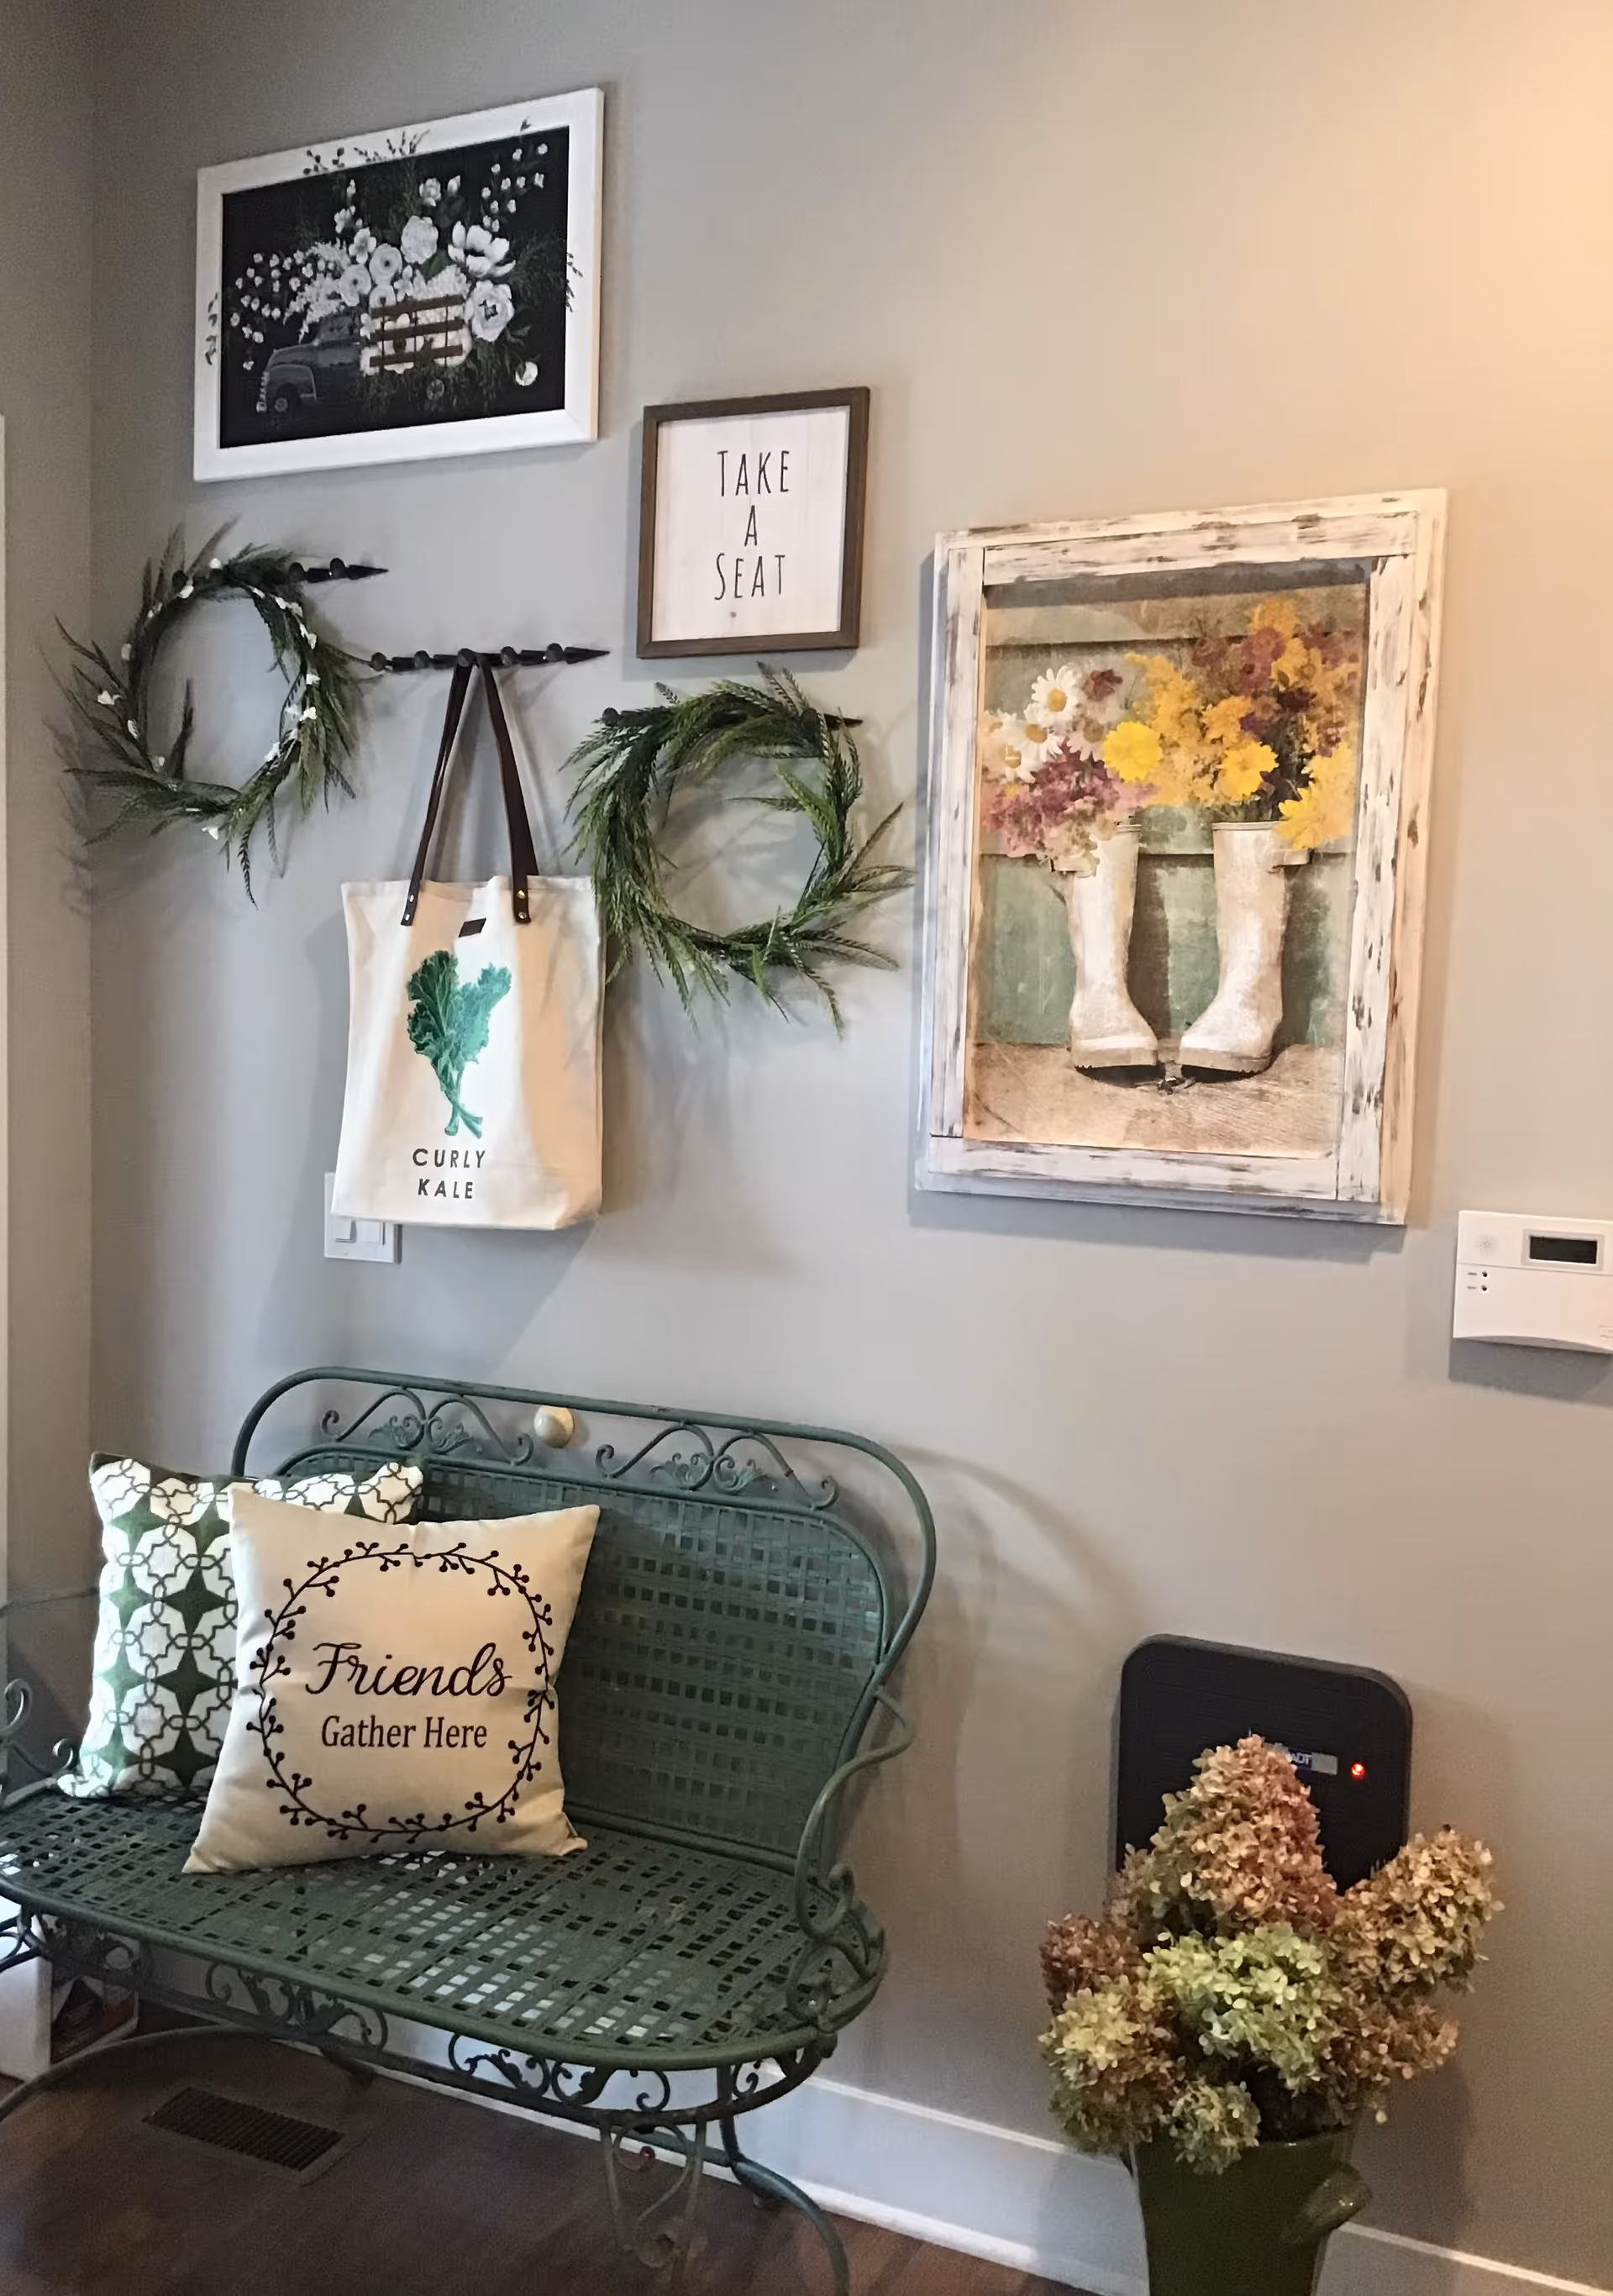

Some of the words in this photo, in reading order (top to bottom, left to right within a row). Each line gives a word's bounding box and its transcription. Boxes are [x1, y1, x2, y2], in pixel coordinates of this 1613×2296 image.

[717, 450, 790, 497] TAKE
[744, 505, 758, 546] A
[714, 552, 785, 600] SEAT
[412, 1148, 486, 1169] CURLY
[418, 1178, 473, 1199] KALE
[305, 1642, 512, 1696] Friends
[322, 1715, 416, 1748] Gather
[423, 1715, 487, 1748] Here
